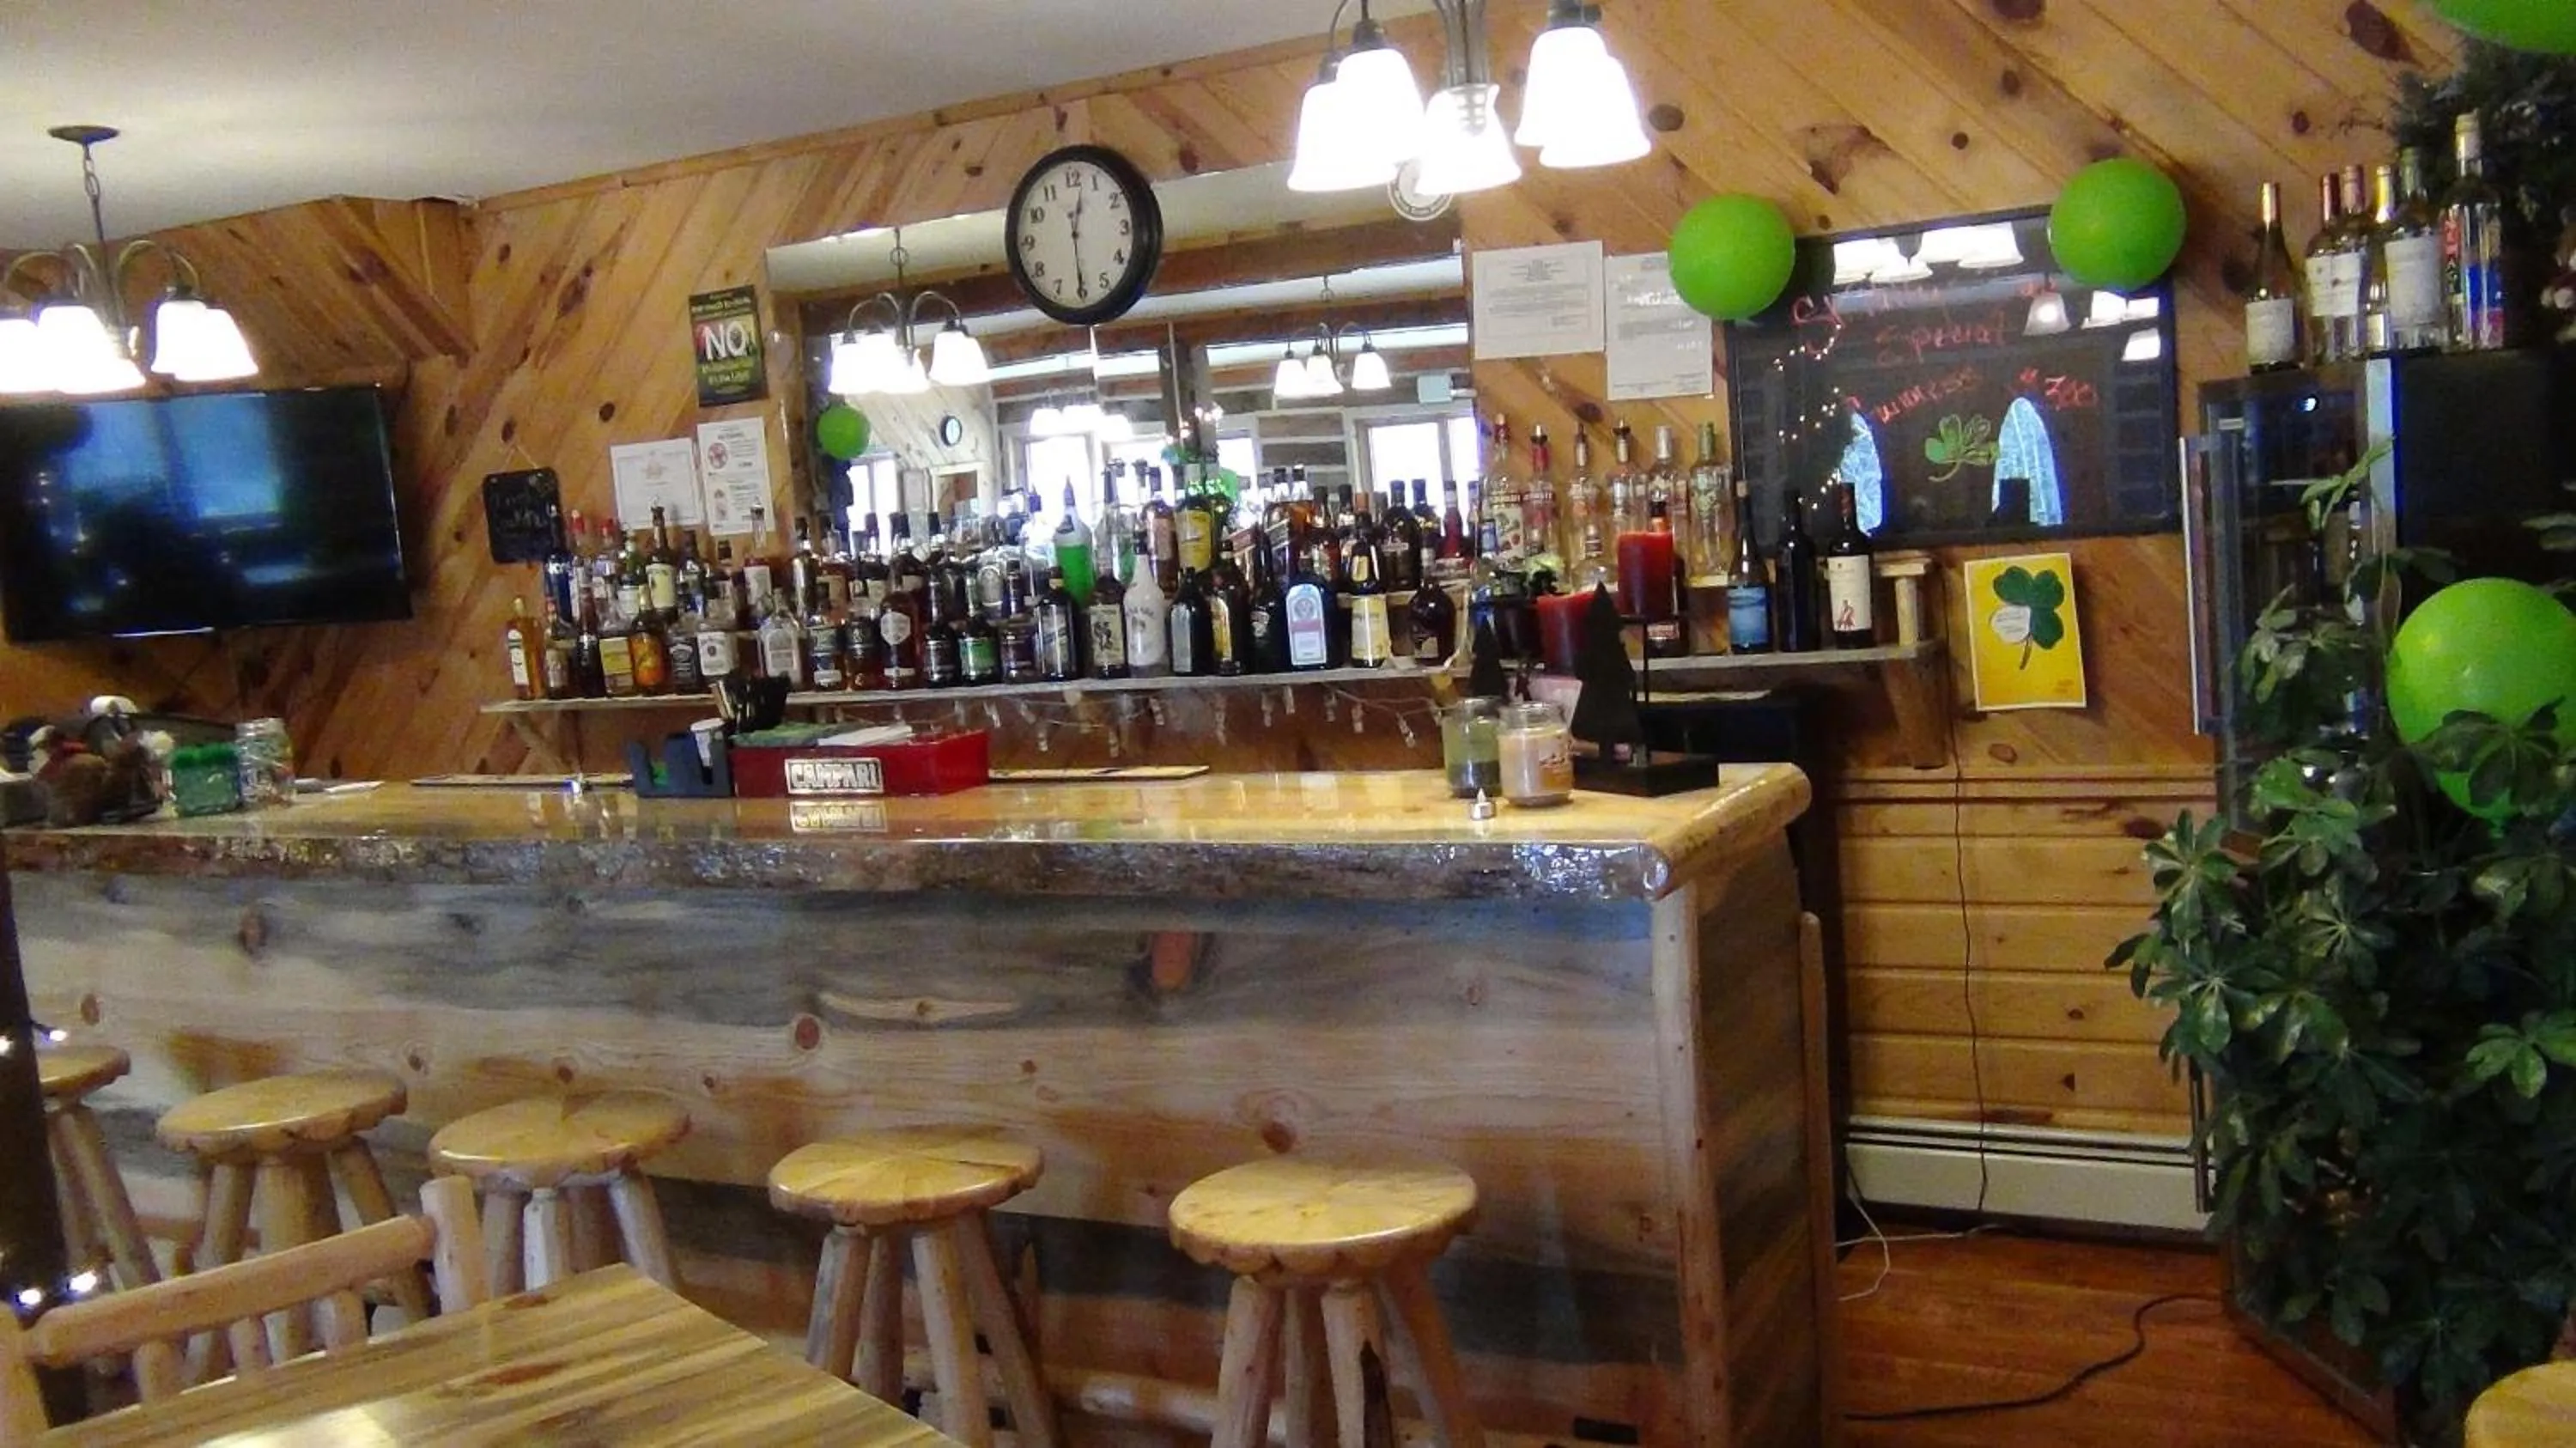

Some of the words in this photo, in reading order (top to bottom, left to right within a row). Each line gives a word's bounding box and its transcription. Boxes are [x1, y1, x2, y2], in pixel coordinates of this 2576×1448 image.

[1066, 170, 1081, 188] 12
[1091, 175, 1098, 191] 1
[1043, 185, 1057, 202] 11
[1109, 192, 1120, 210] 2
[1030, 206, 1045, 223] 10
[1120, 219, 1129, 235] 3
[1022, 234, 1036, 251] 9
[1114, 247, 1124, 265] 4
[1034, 261, 1045, 277] 8
[1054, 279, 1062, 295] 7
[1099, 272, 1109, 289] 5
[1077, 283, 1088, 299] 6
[792, 764, 877, 788] CAMPARI
